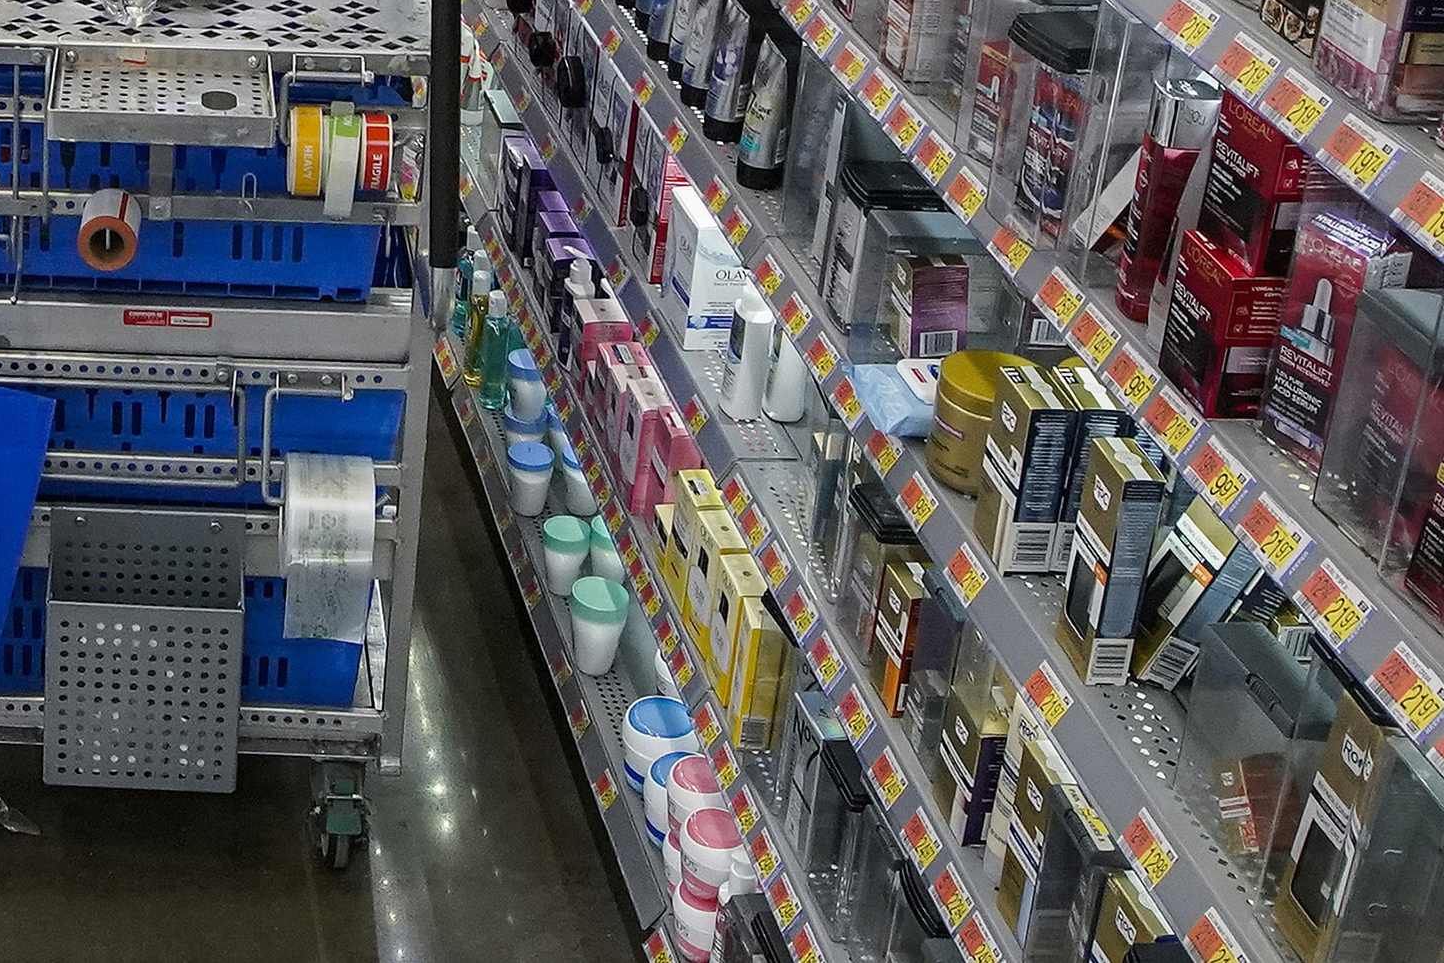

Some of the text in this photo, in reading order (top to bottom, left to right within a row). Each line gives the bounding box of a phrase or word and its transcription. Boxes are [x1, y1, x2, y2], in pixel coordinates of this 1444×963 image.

[1179, 16, 1211, 40] 2197
[1237, 56, 1270, 86] 2197
[1285, 98, 1321, 126] 2197
[304, 144, 313, 180] HEAVY
[370, 153, 384, 189] FRAGILE
[1215, 139, 1260, 179] REVITALIFT
[1354, 147, 1385, 177] 1974
[1175, 279, 1212, 323] REVITALIFT
[1280, 344, 1334, 382] REVITALIFT
[1123, 375, 1152, 402] 997
[1272, 384, 1292, 400] ACID
[1291, 391, 1319, 415] SERUM
[1274, 375, 1323, 409] HYALURONIC
[1164, 415, 1191, 442] 2197
[1210, 472, 1241, 503] 997
[912, 495, 932, 520] 997
[1261, 530, 1295, 563] 2197
[1323, 597, 1360, 632] 2197
[1040, 692, 1067, 721] 2197
[1400, 684, 1441, 720] 2197
[1018, 719, 1038, 743] RoC
[1027, 779, 1043, 811] RoC
[1143, 847, 1168, 880] 1298
[1116, 910, 1137, 943] RoC
